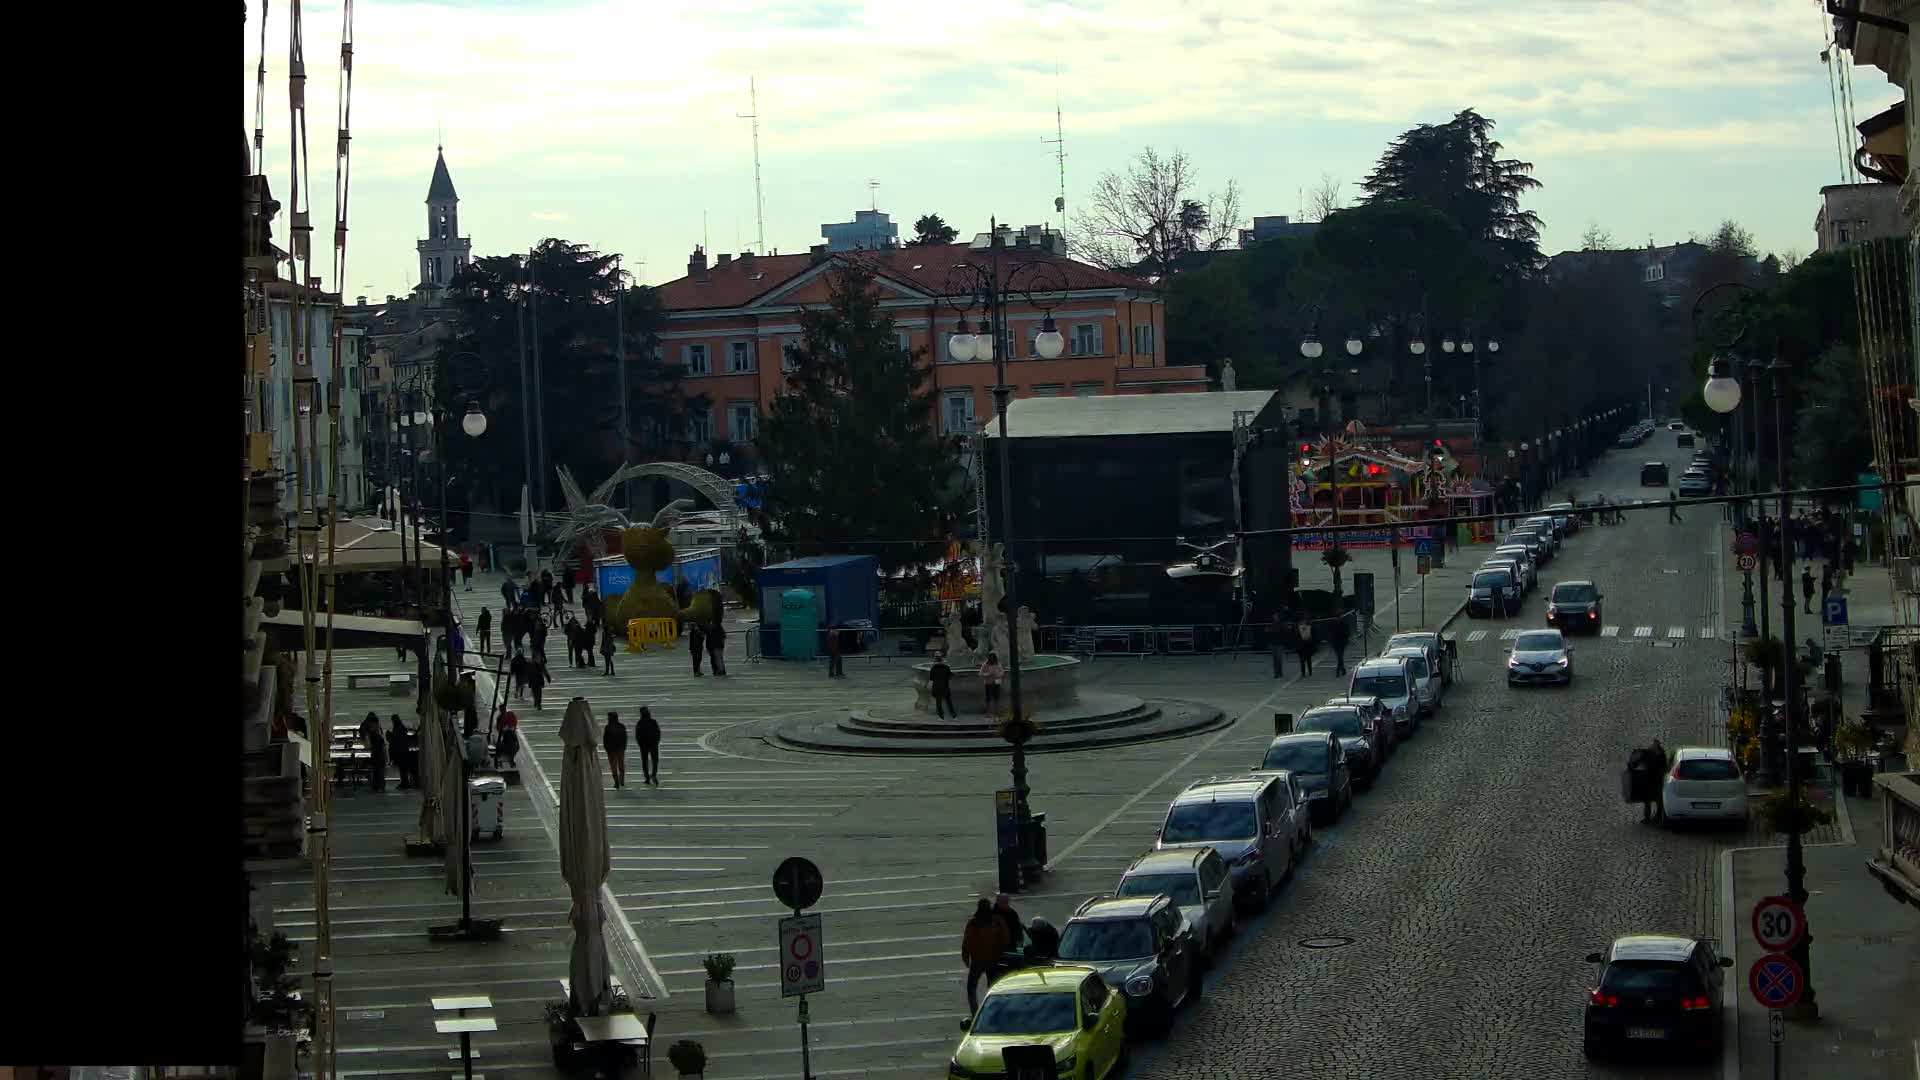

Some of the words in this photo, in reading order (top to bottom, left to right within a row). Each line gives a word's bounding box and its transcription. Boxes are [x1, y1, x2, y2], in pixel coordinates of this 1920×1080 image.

[1742, 557, 1753, 566] 20
[1827, 602, 1841, 622] P
[1762, 911, 1791, 938] 30
